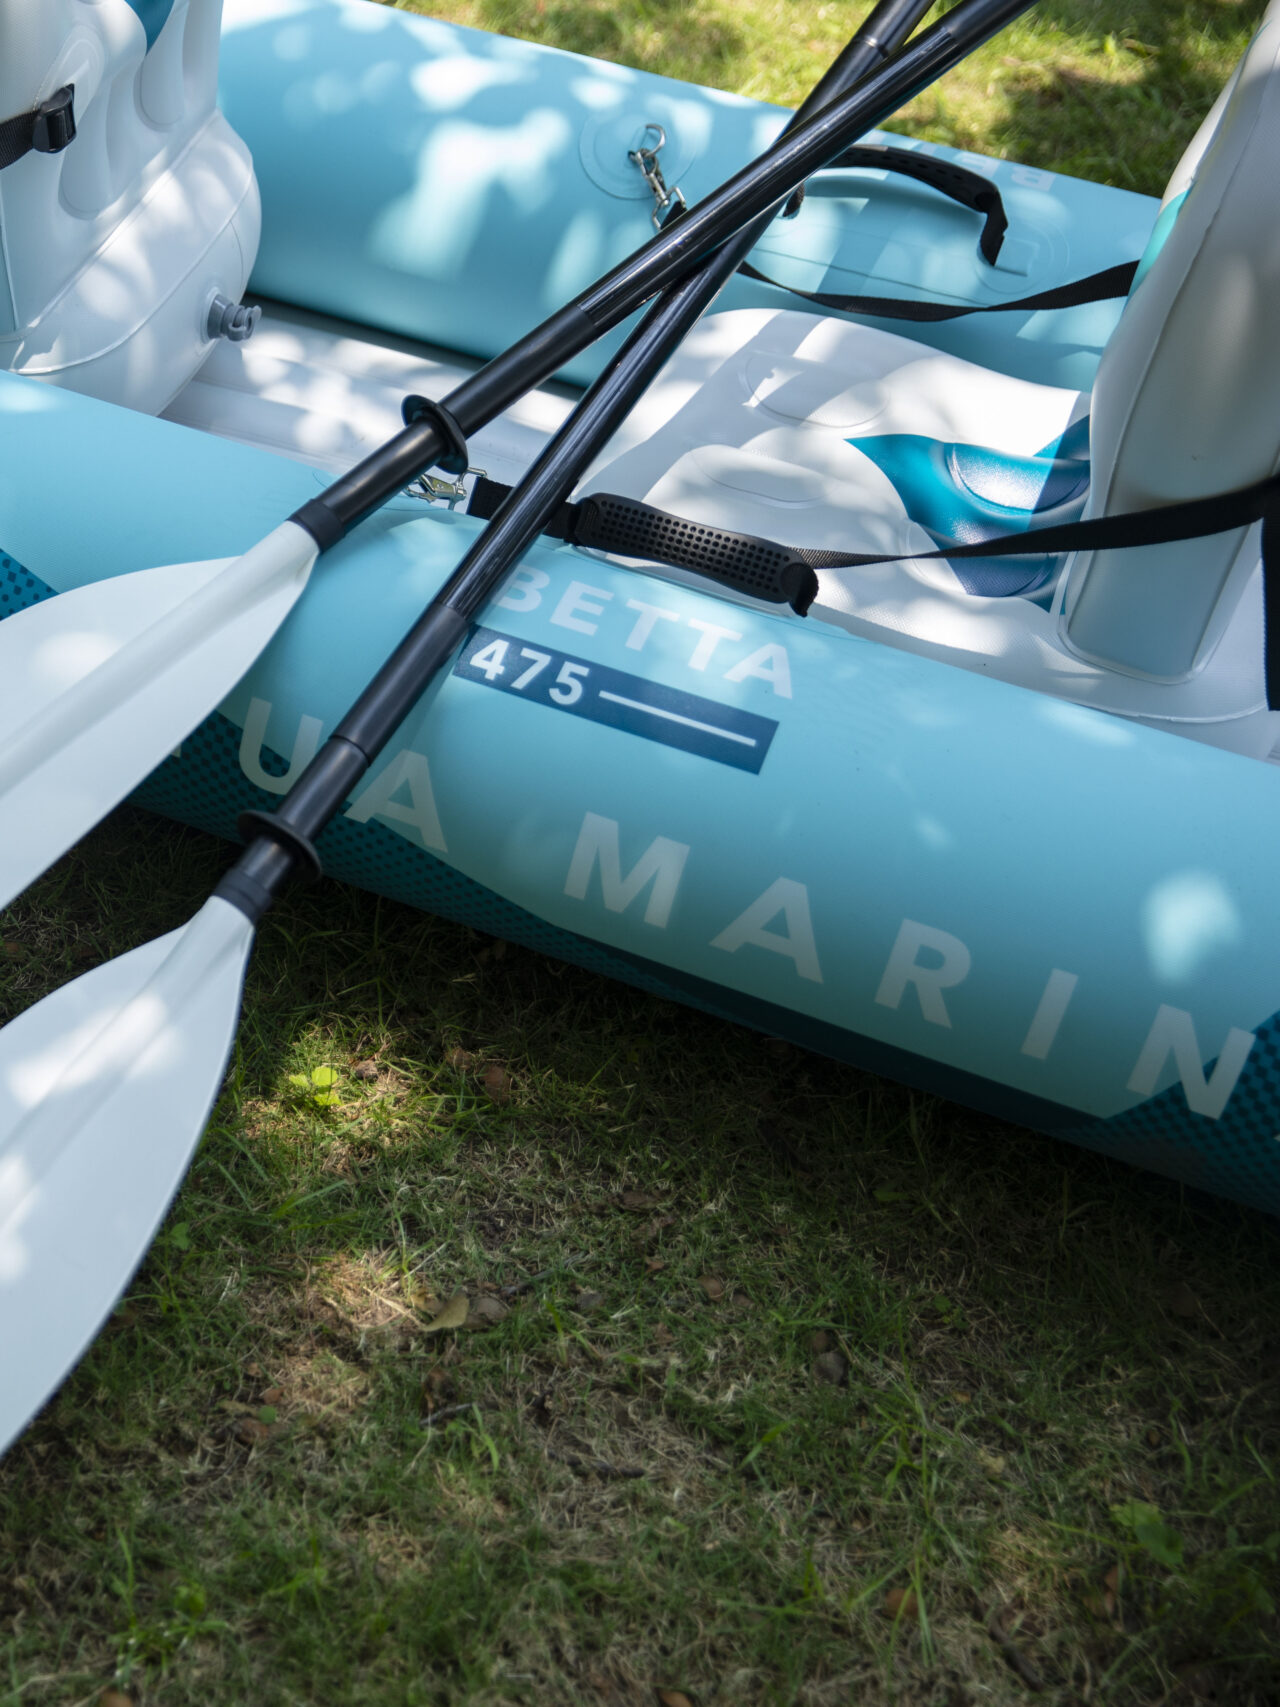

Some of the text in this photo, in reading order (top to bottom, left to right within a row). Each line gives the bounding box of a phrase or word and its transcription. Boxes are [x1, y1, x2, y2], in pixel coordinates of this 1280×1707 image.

[469, 639, 590, 706] 475
[490, 563, 793, 700] BETTA
[169, 697, 1280, 1143] UA MARIN
